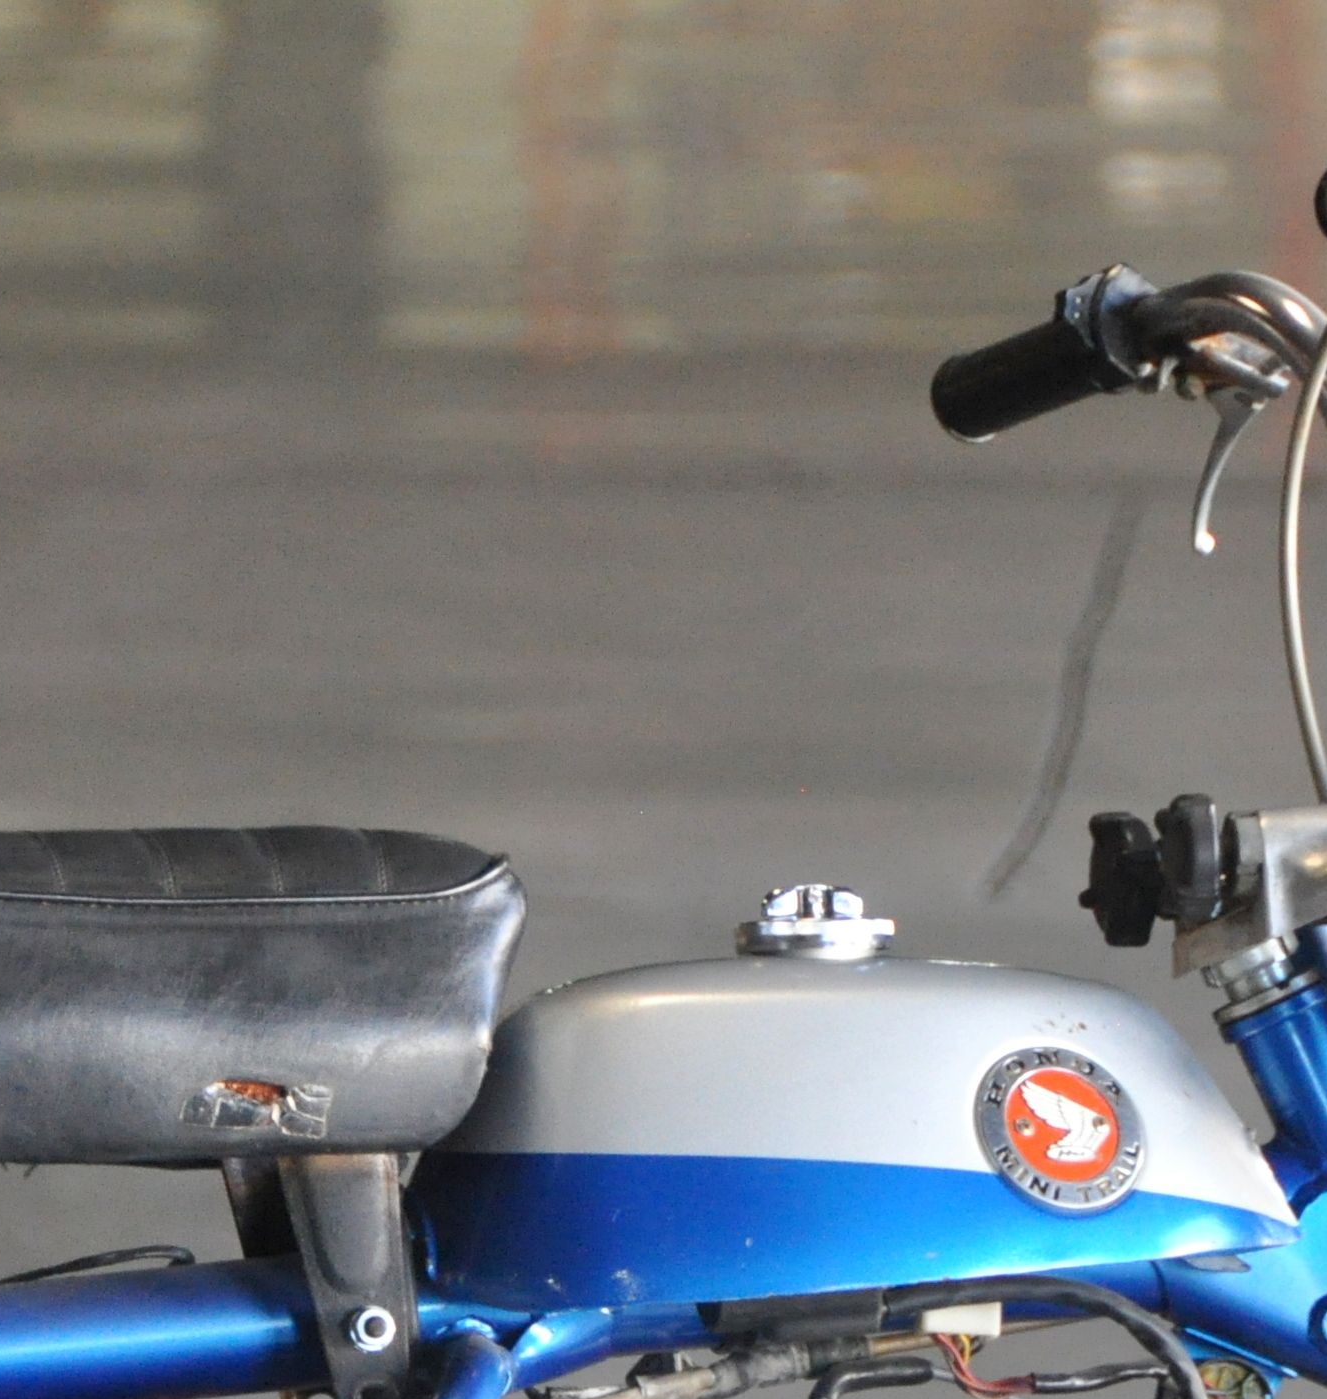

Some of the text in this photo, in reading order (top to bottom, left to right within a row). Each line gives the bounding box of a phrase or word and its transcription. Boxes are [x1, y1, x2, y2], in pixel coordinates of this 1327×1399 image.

[985, 1050, 1122, 1108] HONDA
[995, 1141, 1141, 1202] MINI TRAIL
